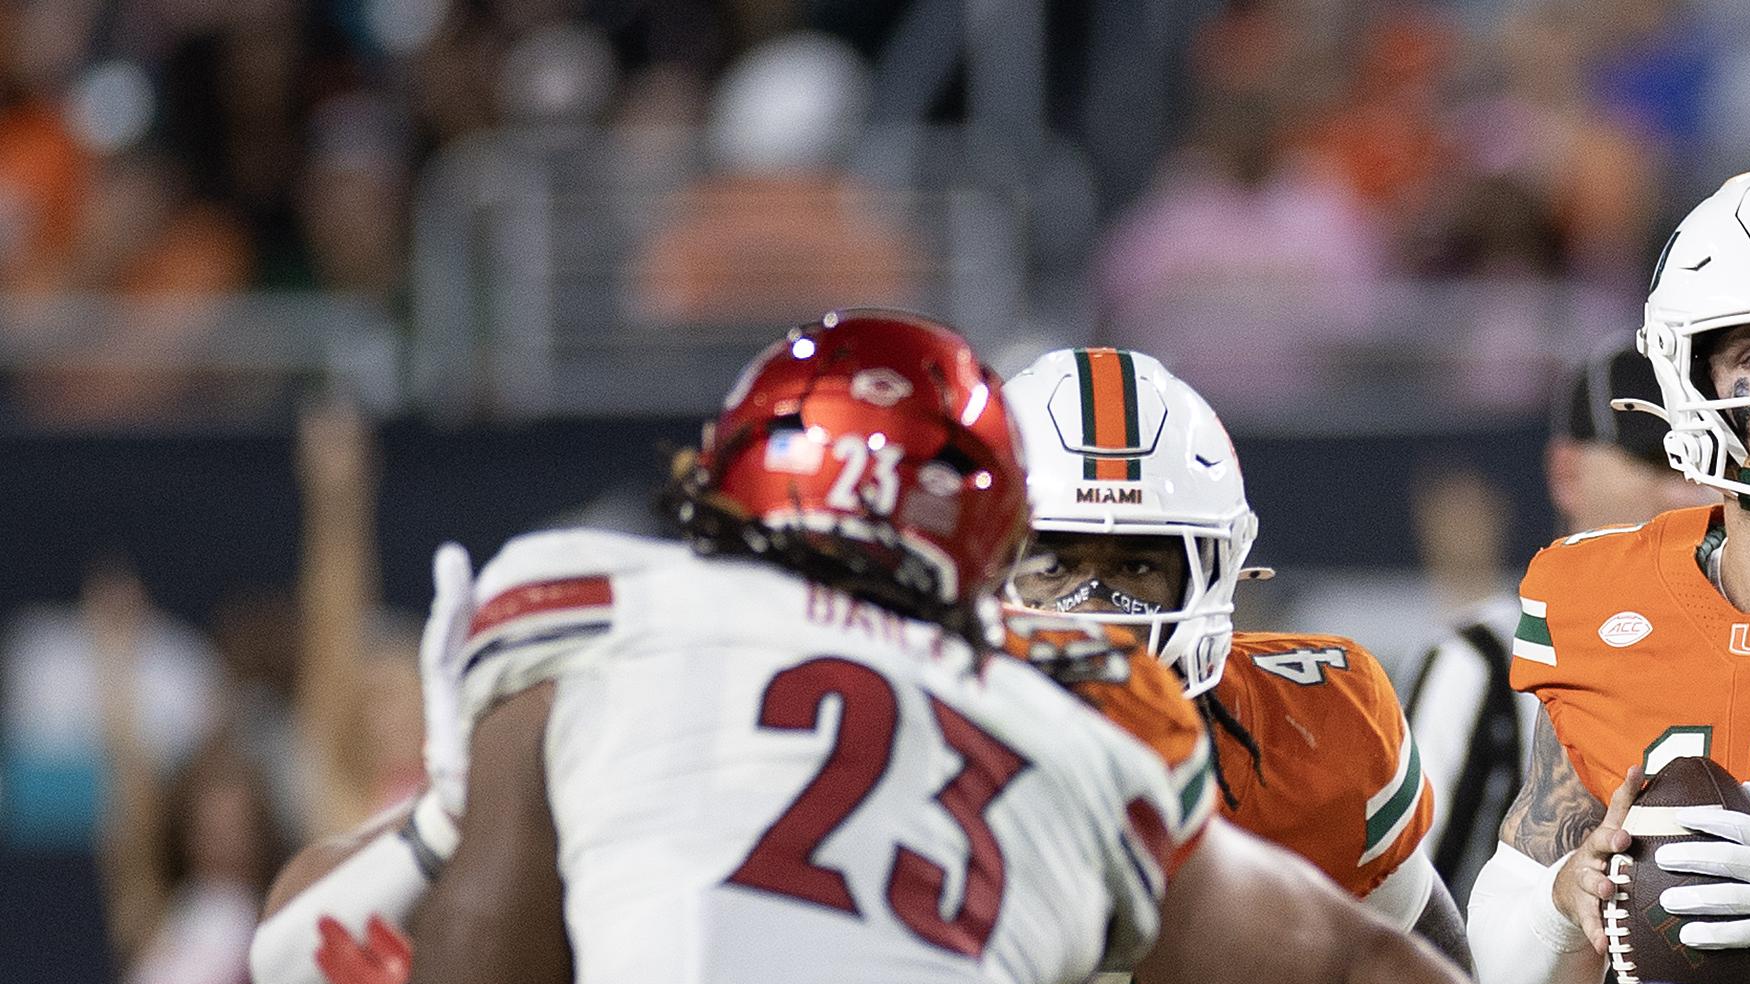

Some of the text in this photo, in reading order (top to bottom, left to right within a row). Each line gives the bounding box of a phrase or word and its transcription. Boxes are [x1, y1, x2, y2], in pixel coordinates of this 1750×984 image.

[827, 434, 904, 515] 23
[1075, 487, 1142, 504] MIAMI
[1607, 622, 1643, 634] ACC
[1252, 647, 1348, 687] 4
[720, 653, 1034, 964] 23
